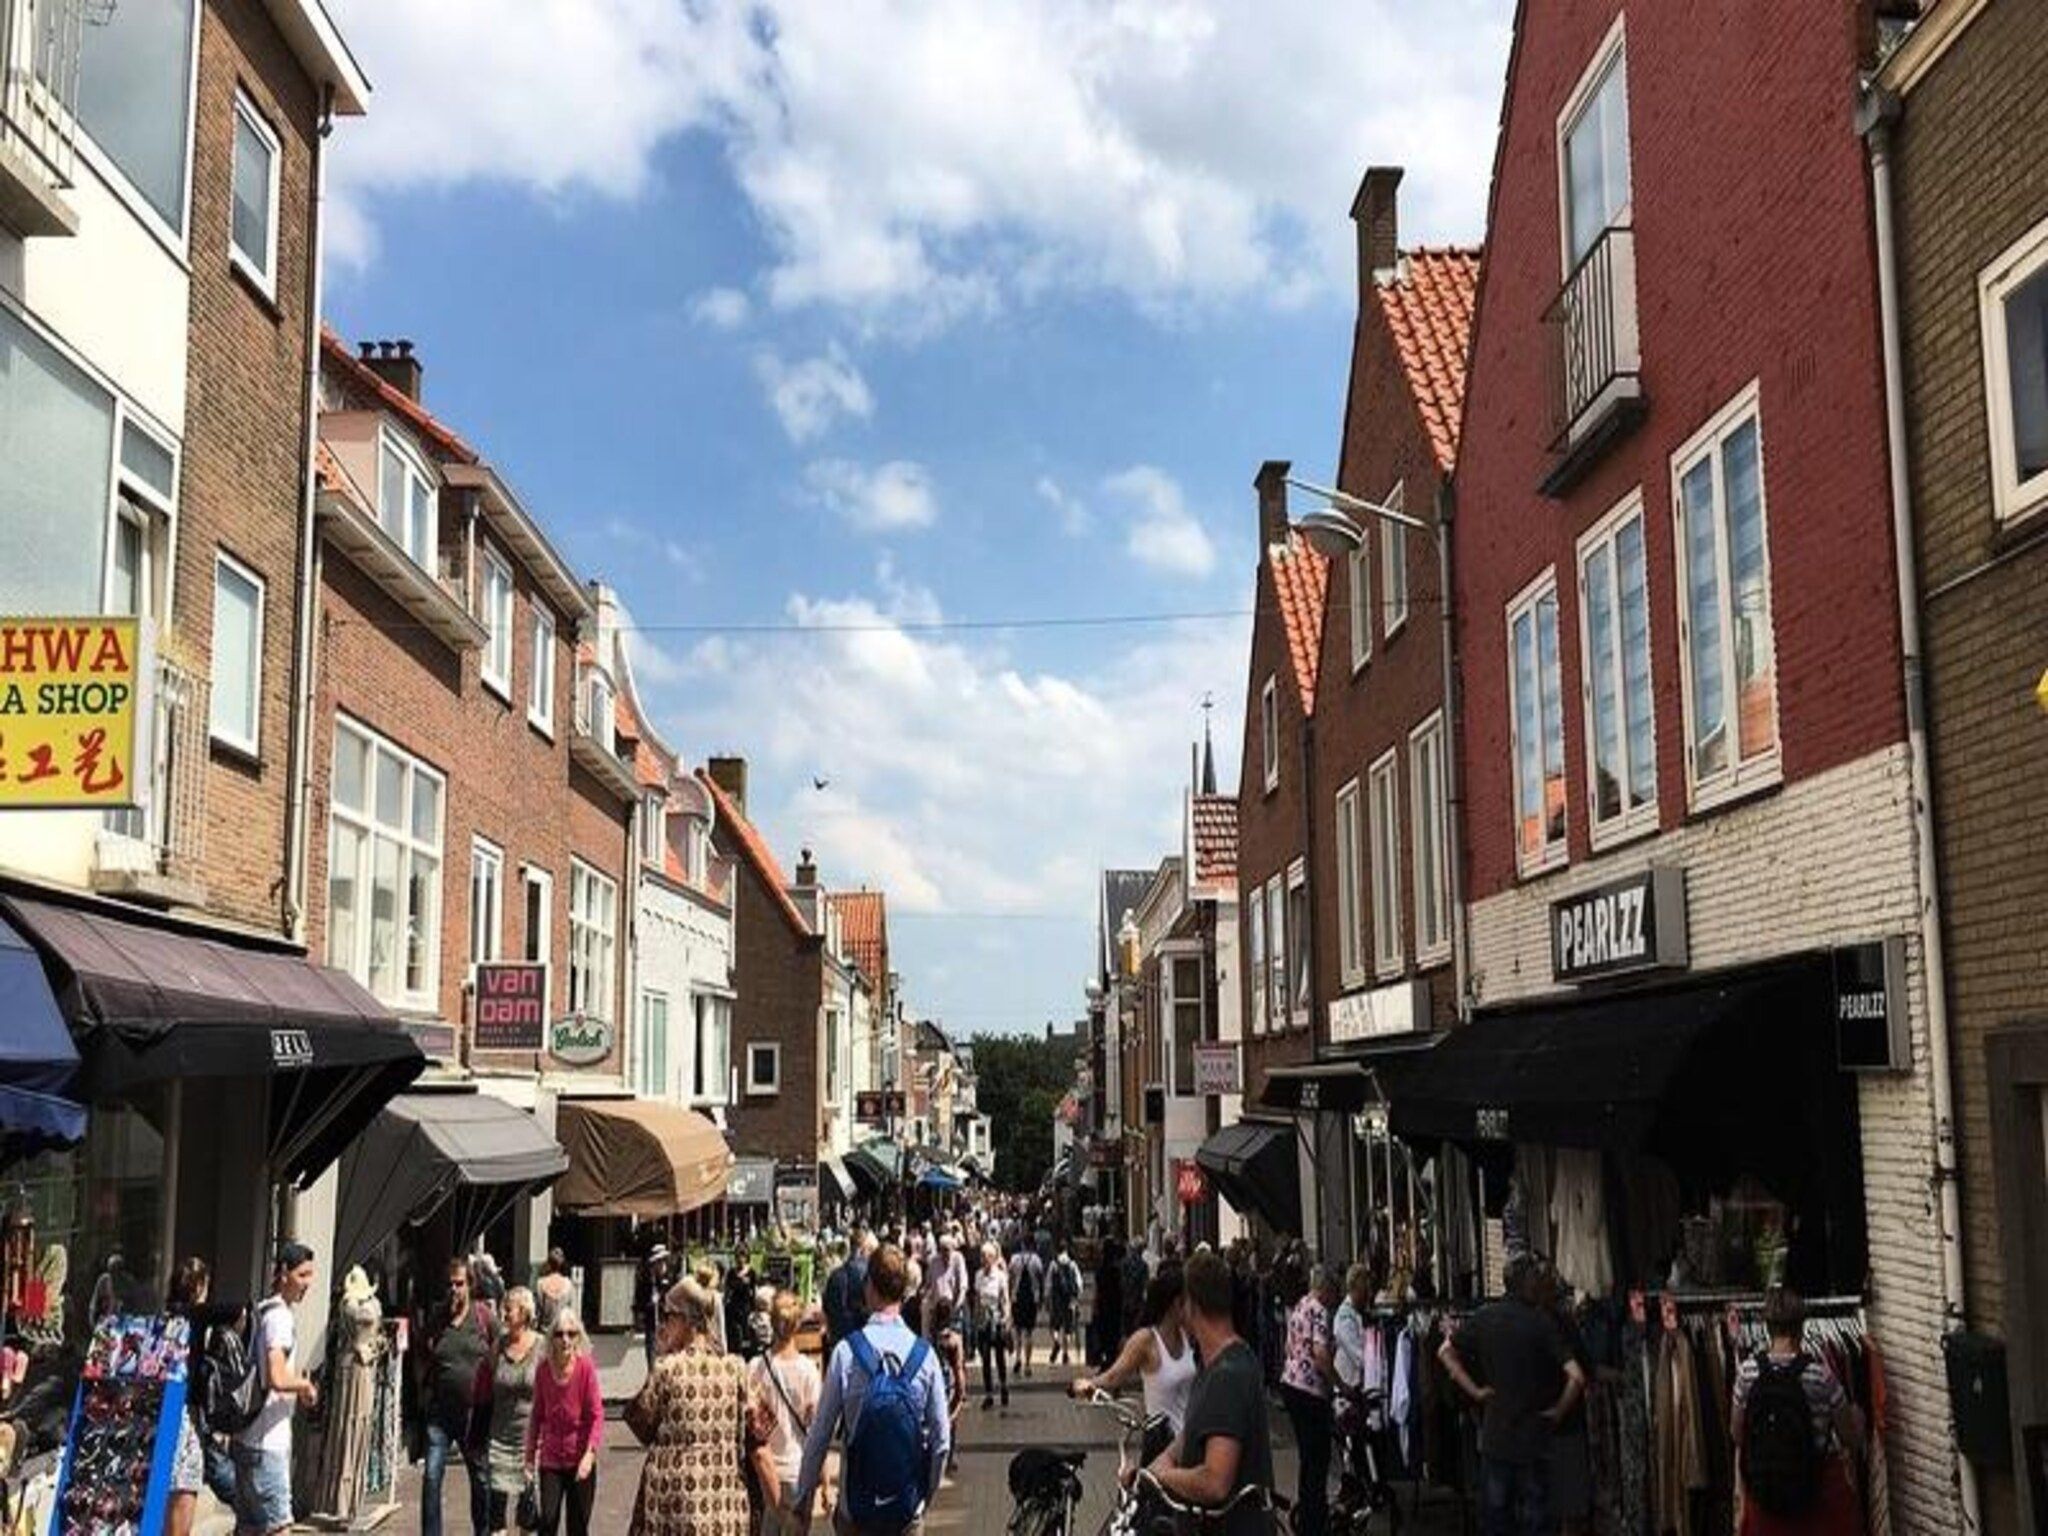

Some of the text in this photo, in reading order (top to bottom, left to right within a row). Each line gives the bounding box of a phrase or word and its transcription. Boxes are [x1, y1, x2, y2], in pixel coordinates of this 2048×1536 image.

[0, 627, 129, 672] HWA
[37, 682, 129, 714] SHOP
[1560, 886, 1647, 970] PEARLZZ
[485, 970, 537, 993] van
[1839, 991, 1886, 1019] PEARLZZ
